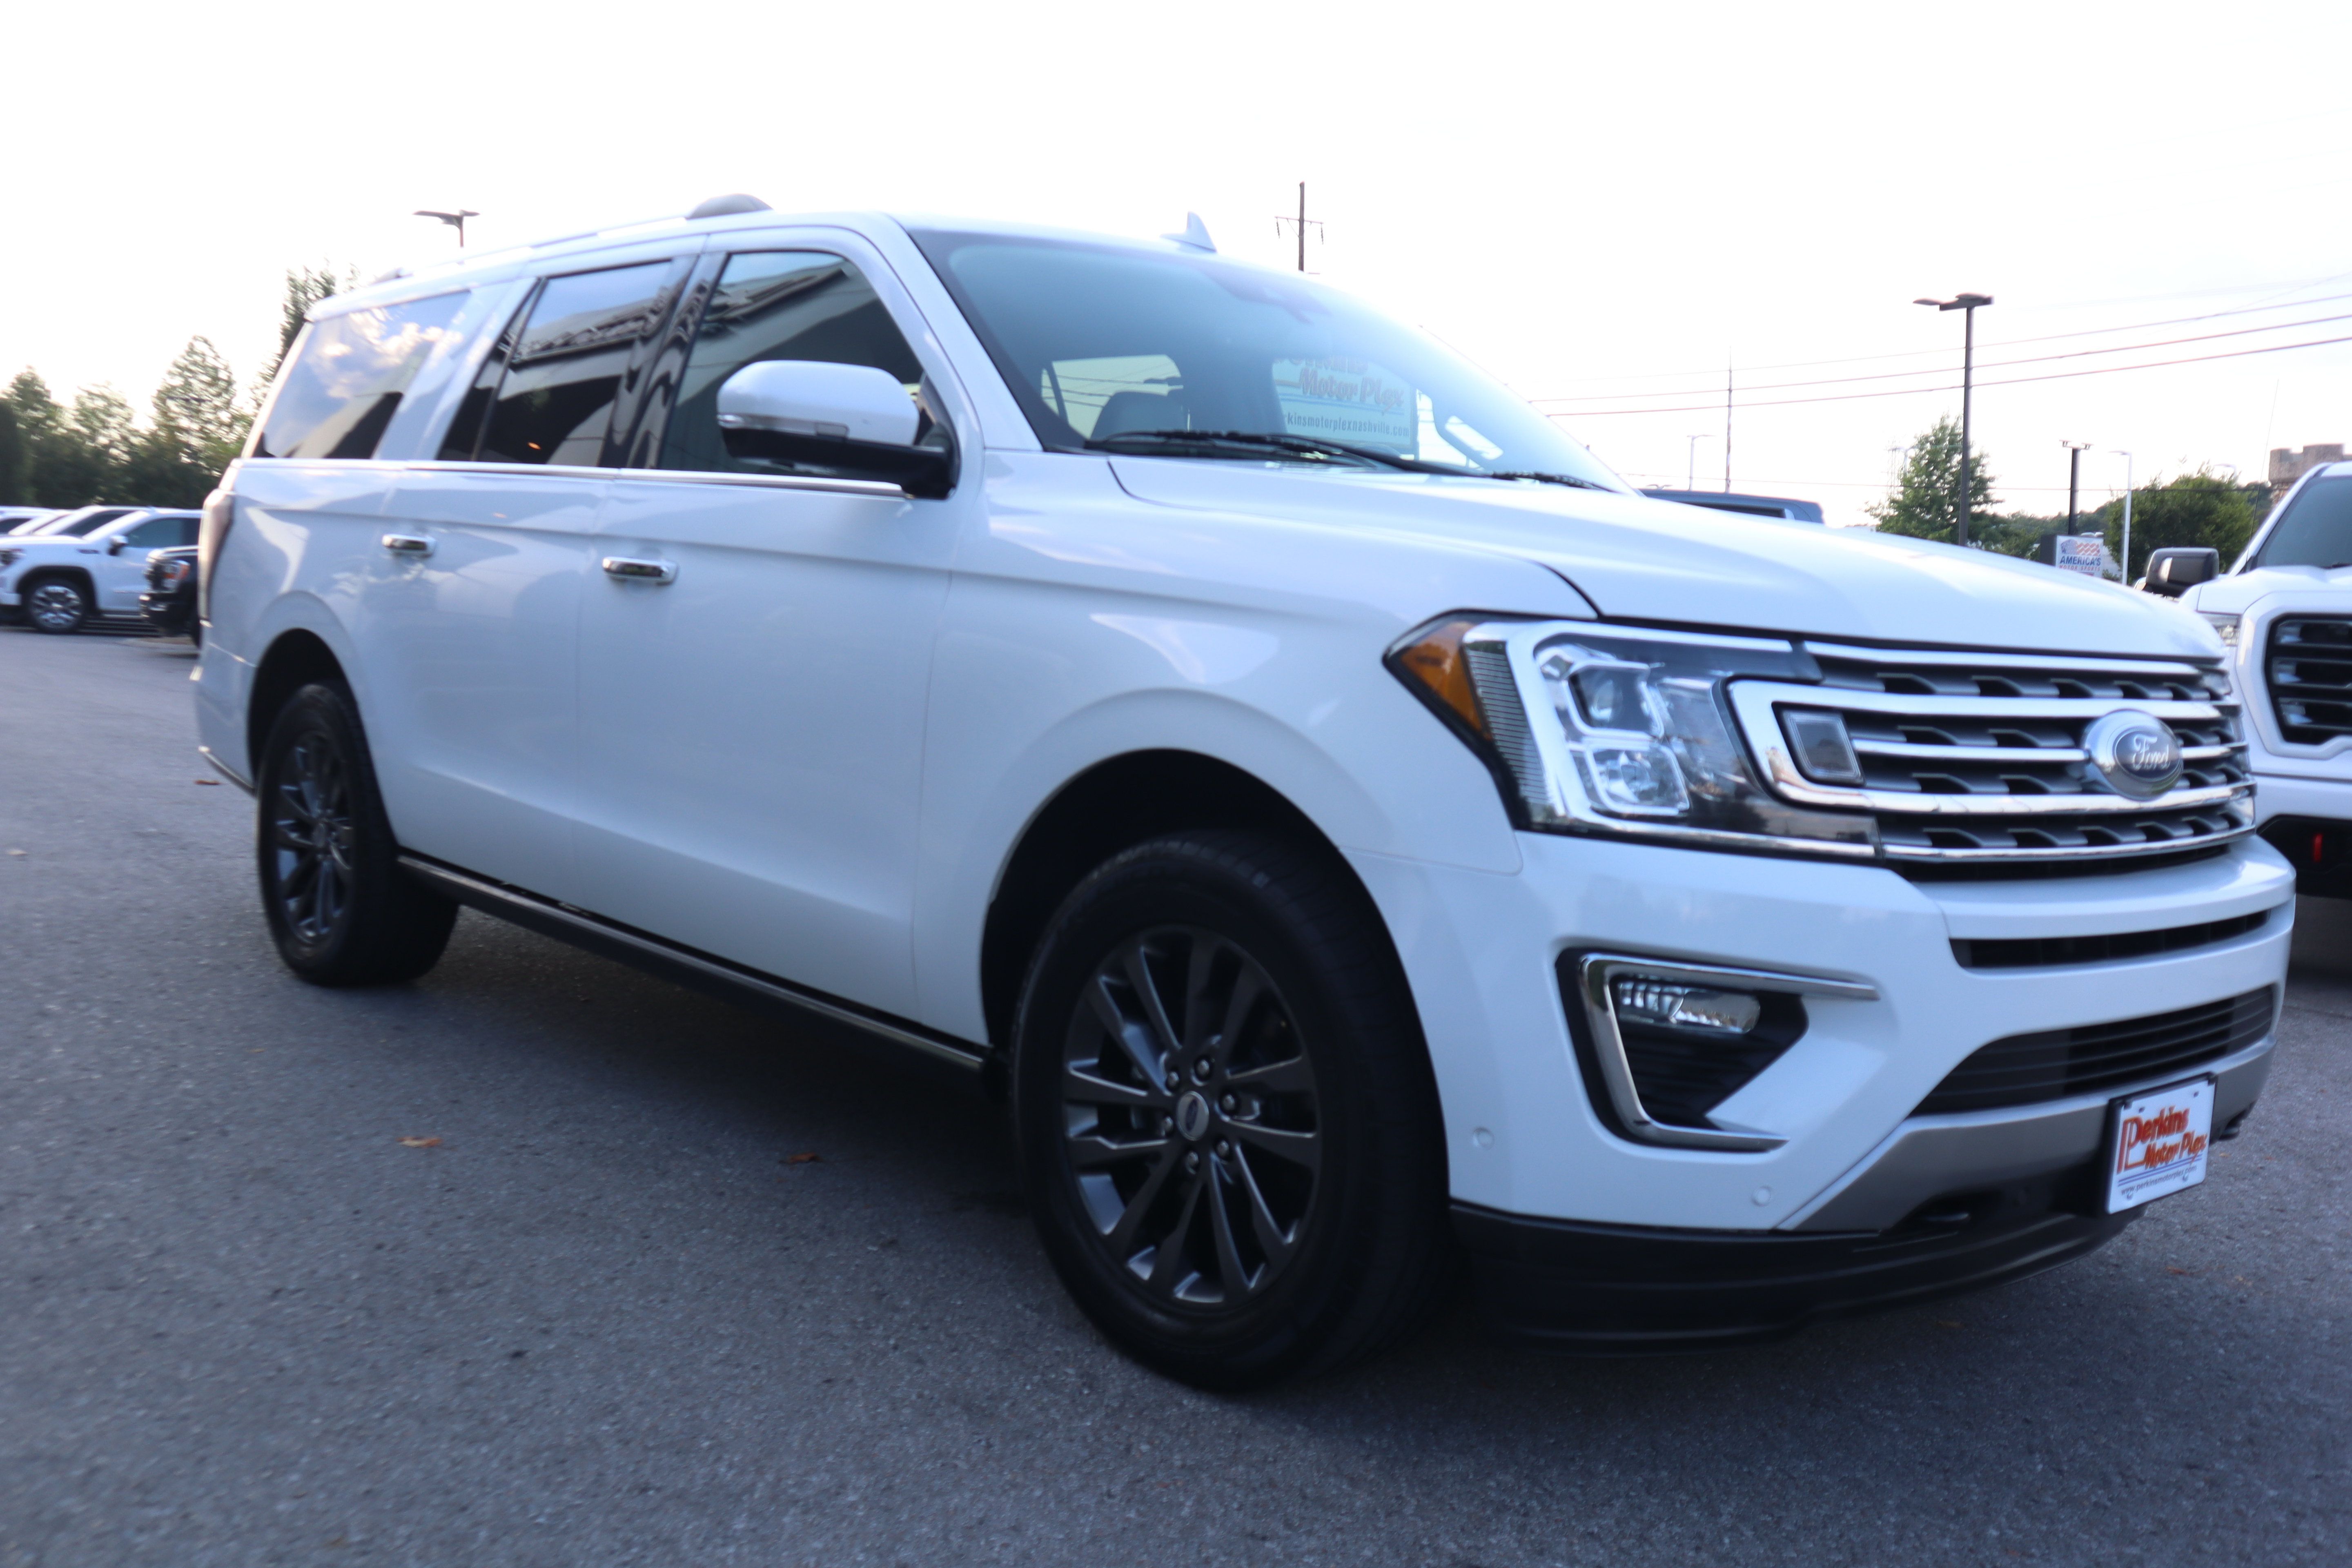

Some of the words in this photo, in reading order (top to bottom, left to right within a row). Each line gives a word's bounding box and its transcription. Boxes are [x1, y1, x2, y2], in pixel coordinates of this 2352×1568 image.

[1299, 368, 1358, 401] Motor
[1360, 376, 1405, 415] Plex
[2060, 556, 2101, 566] AMERICA'S
[2132, 735, 2170, 771] Ford
[2117, 1105, 2190, 1174] Perkins
[2144, 1143, 2180, 1169] Motor
[2178, 1130, 2207, 1164] Plex
[2121, 1165, 2197, 1196] www.perkinsmotorplex.com
